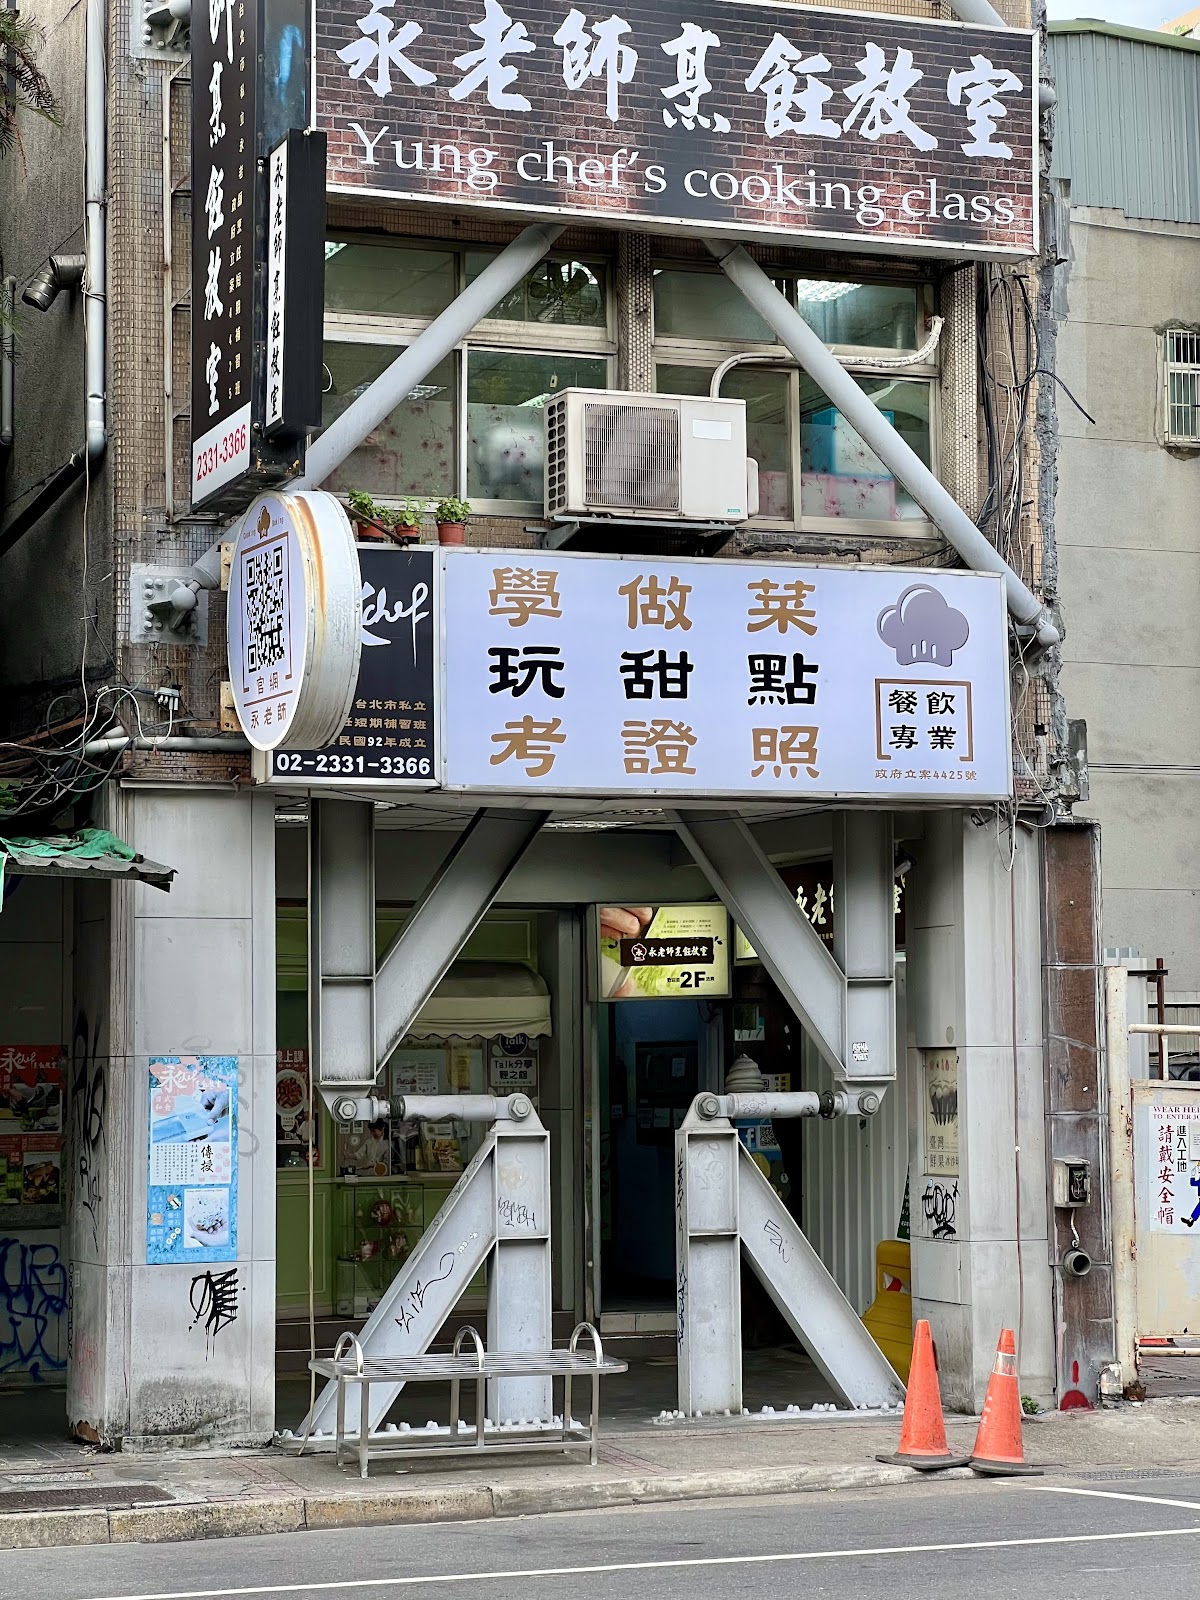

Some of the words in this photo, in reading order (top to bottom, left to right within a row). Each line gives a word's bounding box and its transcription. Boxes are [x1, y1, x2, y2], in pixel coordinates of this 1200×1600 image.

[336, 0, 1024, 160] 永老師烹飪教室
[348, 122, 500, 190] Yung
[515, 140, 666, 195] chef's
[683, 164, 885, 227] cooking
[900, 178, 1016, 225] class
[270, 155, 284, 418] 永老師烹飪教室
[195, 424, 247, 482] 2331-3366
[256, 671, 279, 695] 官網
[250, 702, 287, 729] 永老師
[355, 698, 427, 711] 台北市私立
[887, 688, 956, 716] 餐飲
[329, 735, 427, 749] 民國92年成立
[276, 753, 431, 776] 02-2331-3366
[874, 768, 978, 781] 政府立案4425號
[648, 946, 709, 958] 永老師烹飪教室
[679, 971, 706, 989] 2F
[200, 1143, 214, 1173] 傳授
[1176, 1125, 1187, 1173] 進入工地
[1157, 1124, 1175, 1226] 請戴安全帽
